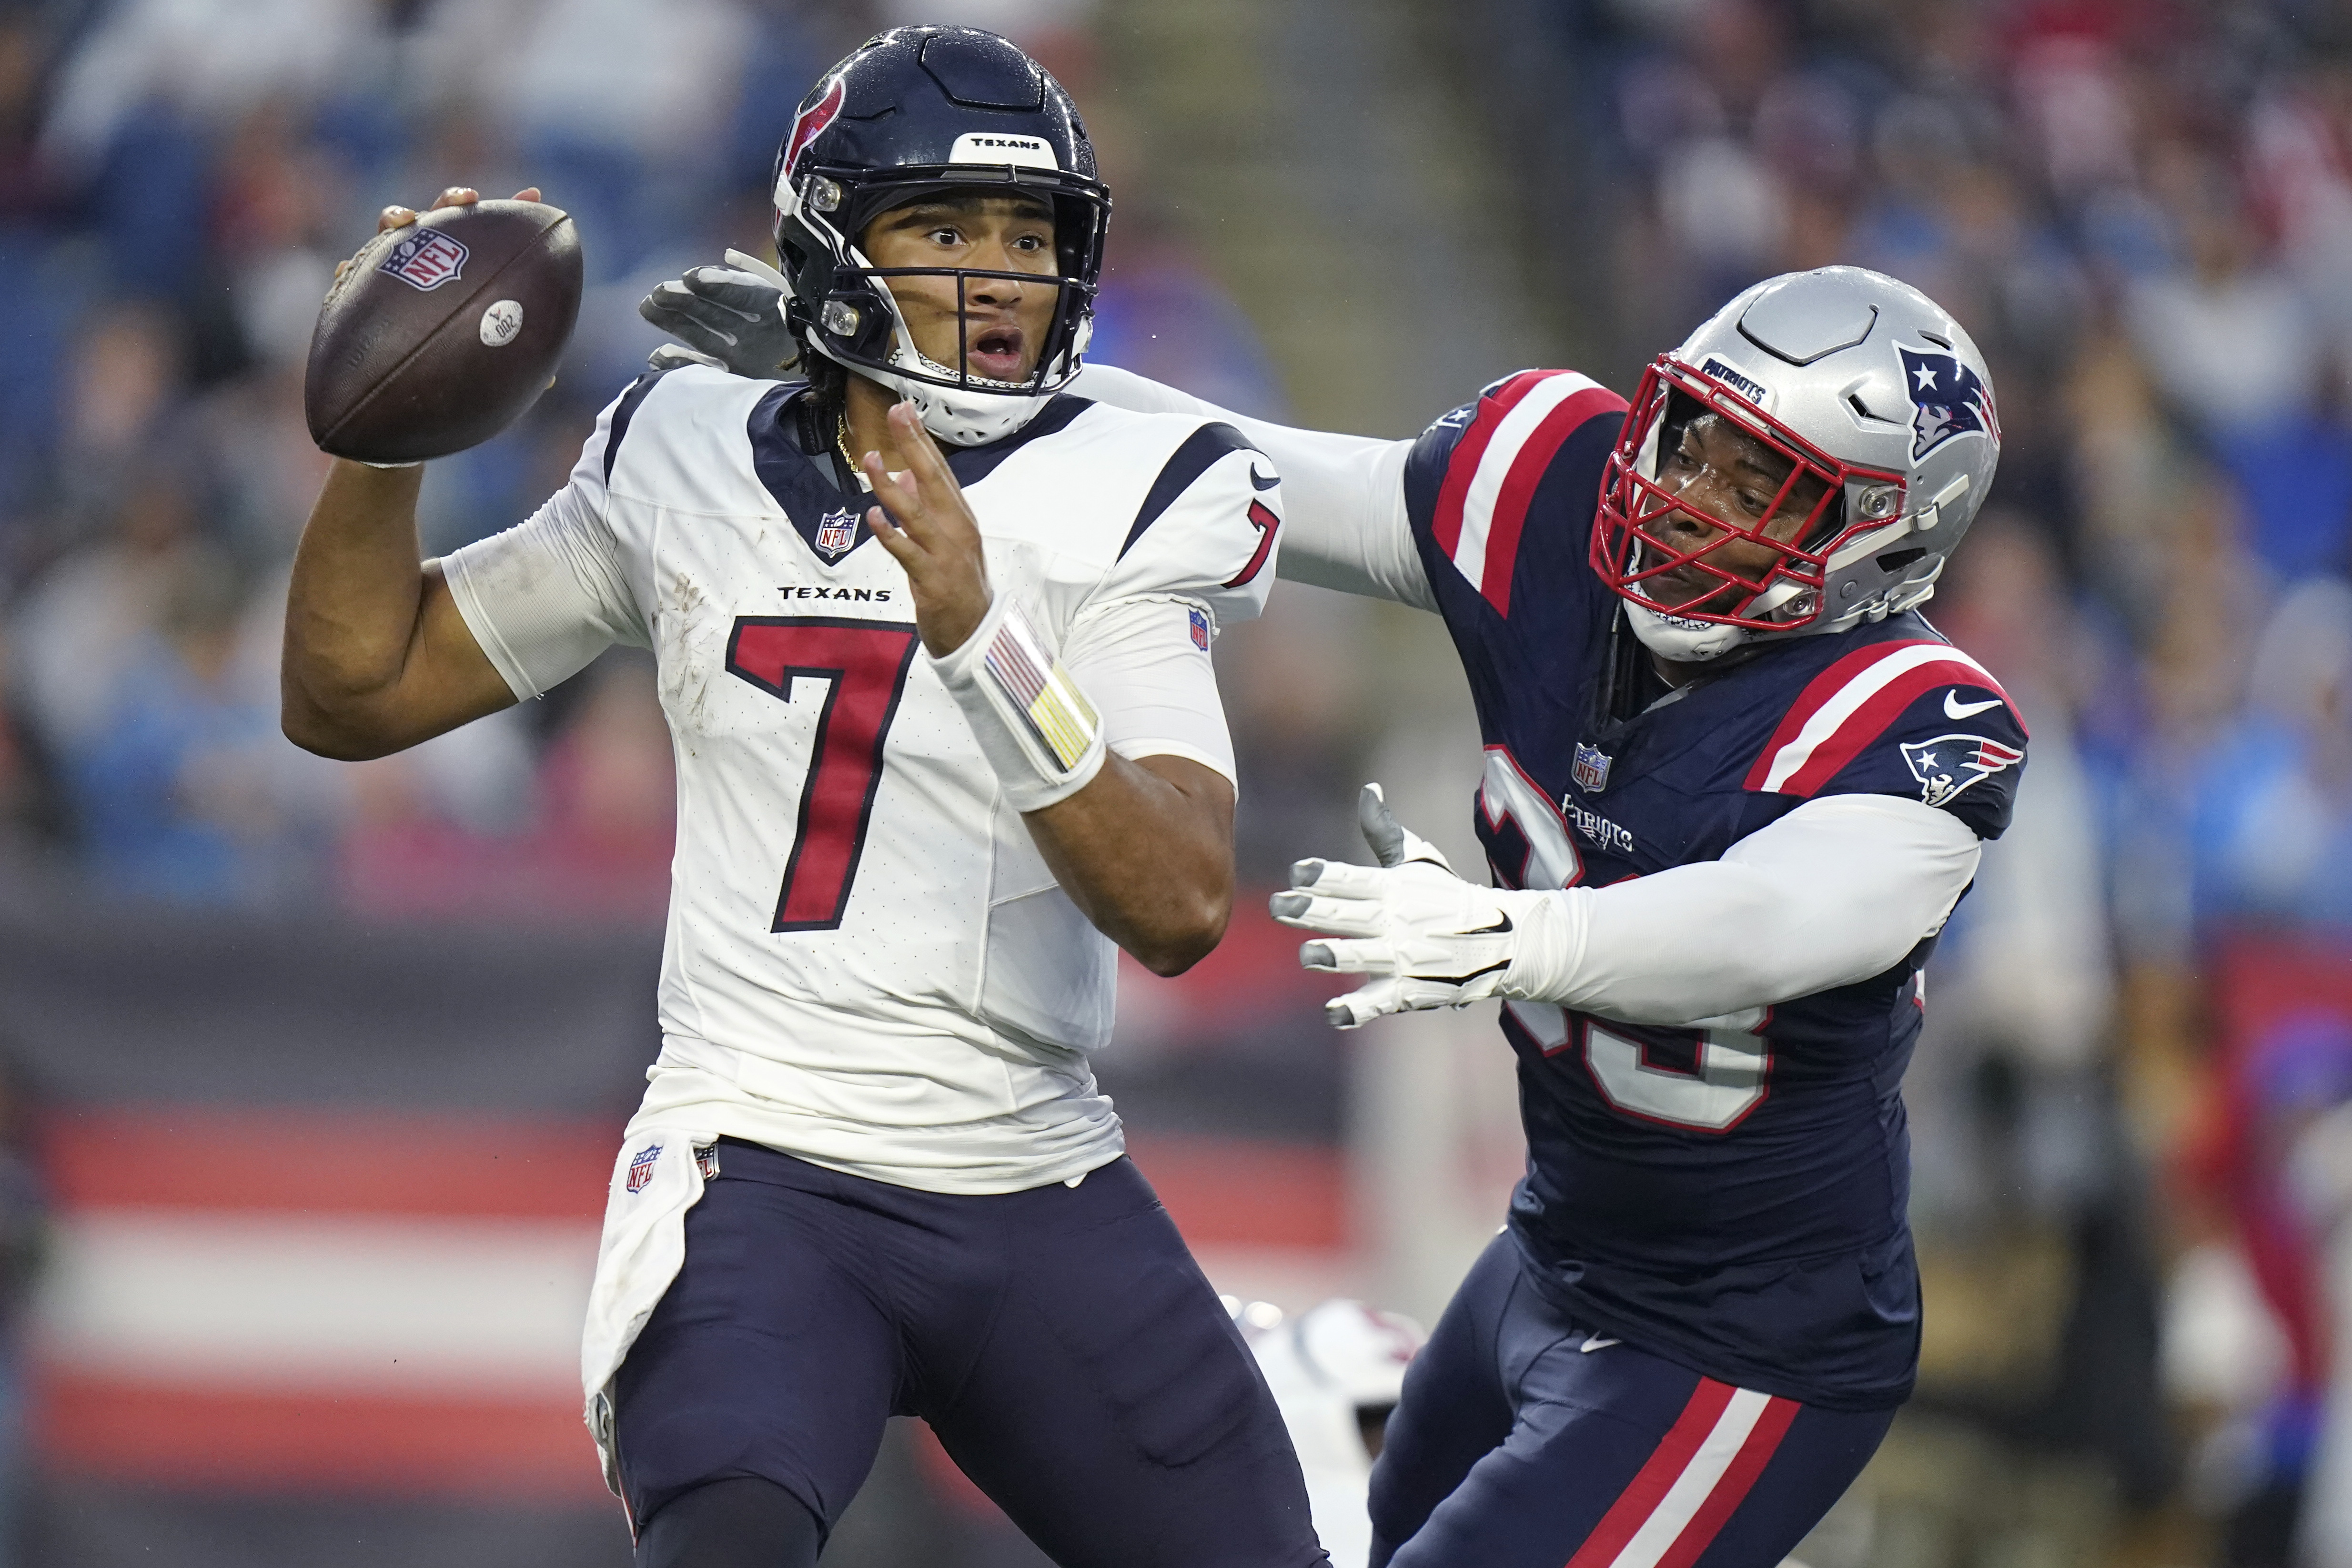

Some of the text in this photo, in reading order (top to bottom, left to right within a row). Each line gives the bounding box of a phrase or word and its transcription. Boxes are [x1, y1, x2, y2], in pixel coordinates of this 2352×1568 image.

[970, 138, 1040, 149] TEXANS
[404, 242, 461, 283] NFL
[495, 314, 515, 338] 002
[1700, 357, 1766, 405] PATRIOTS
[821, 529, 847, 547] NFL
[1220, 497, 1281, 589] 7
[777, 586, 892, 601] TEXANS
[1192, 623, 1207, 647] NFL
[725, 616, 922, 933] 7
[1576, 761, 1600, 786] NFL
[1562, 793, 1633, 852] PTRIOTS
[627, 1162, 652, 1188] NFL
